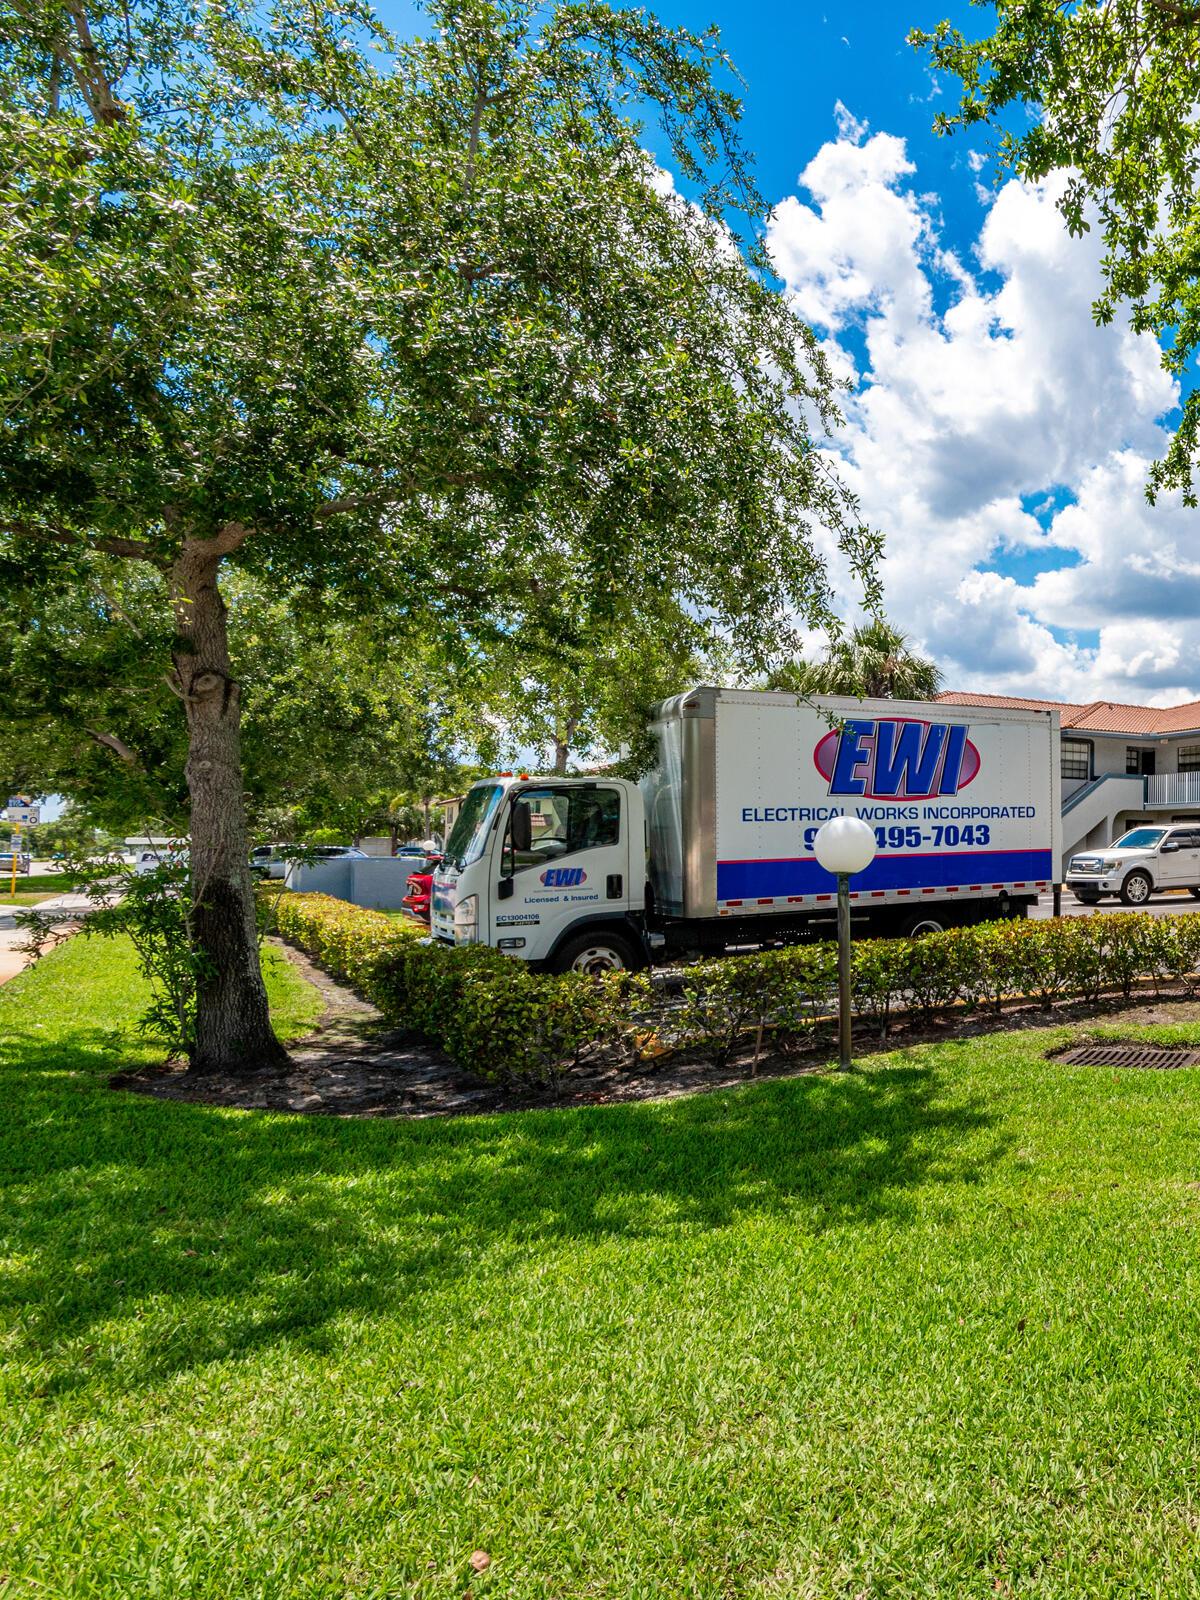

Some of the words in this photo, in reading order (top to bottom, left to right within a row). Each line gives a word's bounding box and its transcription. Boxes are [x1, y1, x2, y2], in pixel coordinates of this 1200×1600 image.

[828, 718, 969, 797] EWI
[742, 807, 845, 822] ELECTRICAL
[856, 807, 919, 820] WORKS
[923, 806, 1036, 820] INCORPORATED
[544, 868, 583, 887] EWI
[524, 896, 559, 904] Licensed
